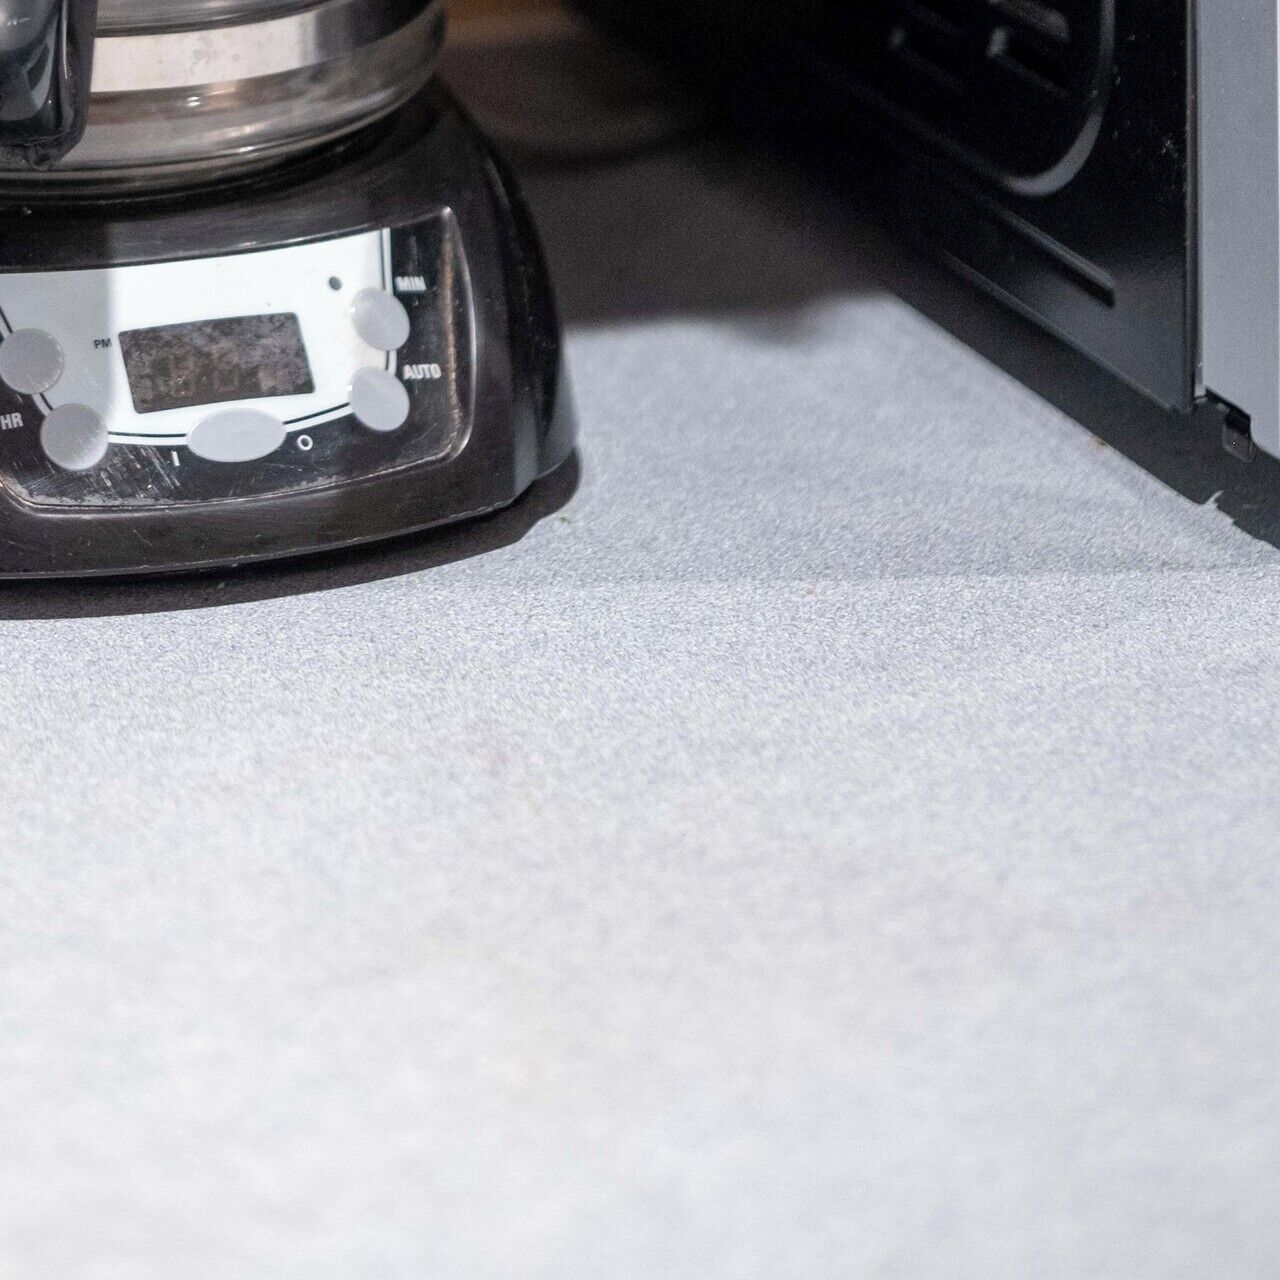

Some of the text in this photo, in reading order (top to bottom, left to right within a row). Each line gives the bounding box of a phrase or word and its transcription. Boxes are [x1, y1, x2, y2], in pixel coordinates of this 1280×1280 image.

[396, 275, 427, 291] MIN
[94, 338, 112, 350] PM
[403, 363, 441, 379] AUTO
[0, 412, 24, 430] HR
